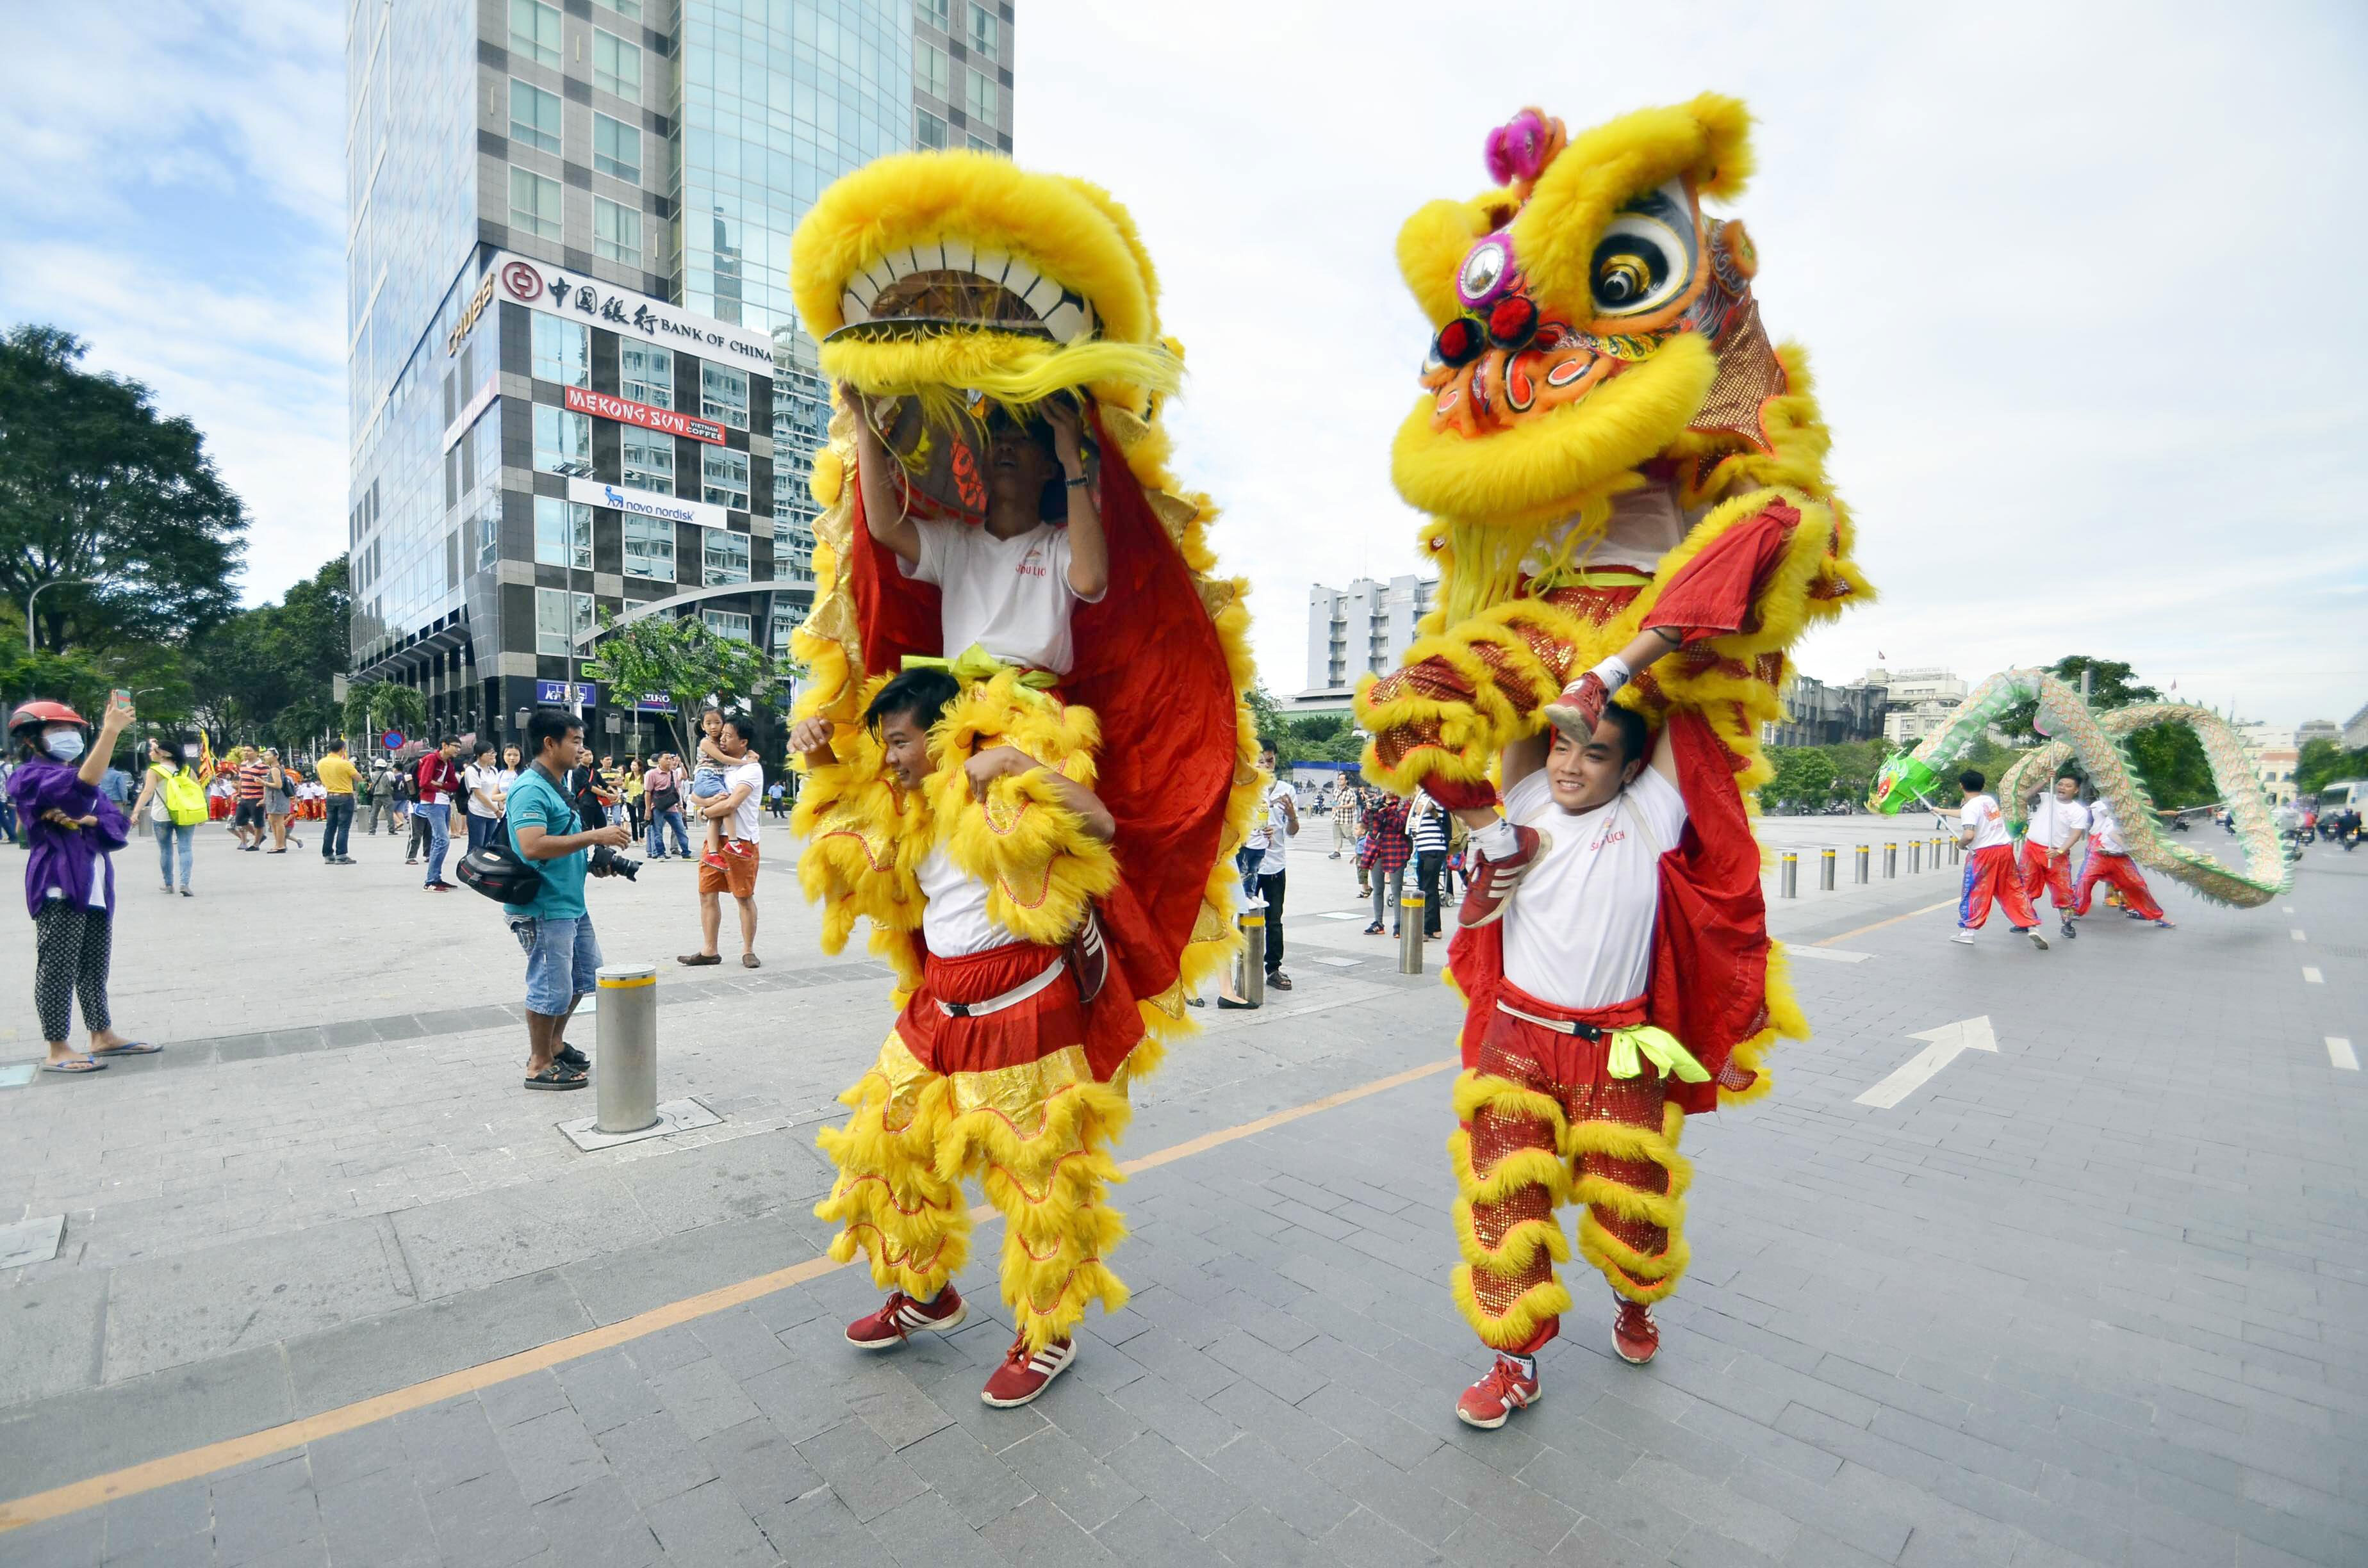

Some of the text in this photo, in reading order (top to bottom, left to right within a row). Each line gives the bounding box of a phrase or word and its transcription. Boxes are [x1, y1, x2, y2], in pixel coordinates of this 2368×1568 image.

[448, 272, 494, 357] CHUBB
[548, 277, 659, 336] 中國銀行
[661, 318, 773, 363] BANK OF CHINA
[569, 389, 684, 432] MEKONG SUN
[686, 427, 723, 441] COFFEE
[690, 421, 718, 432] VIETNAM
[626, 502, 693, 521] novo nordisk
[545, 690, 586, 702] KPG
[639, 693, 671, 703] IZUHO
